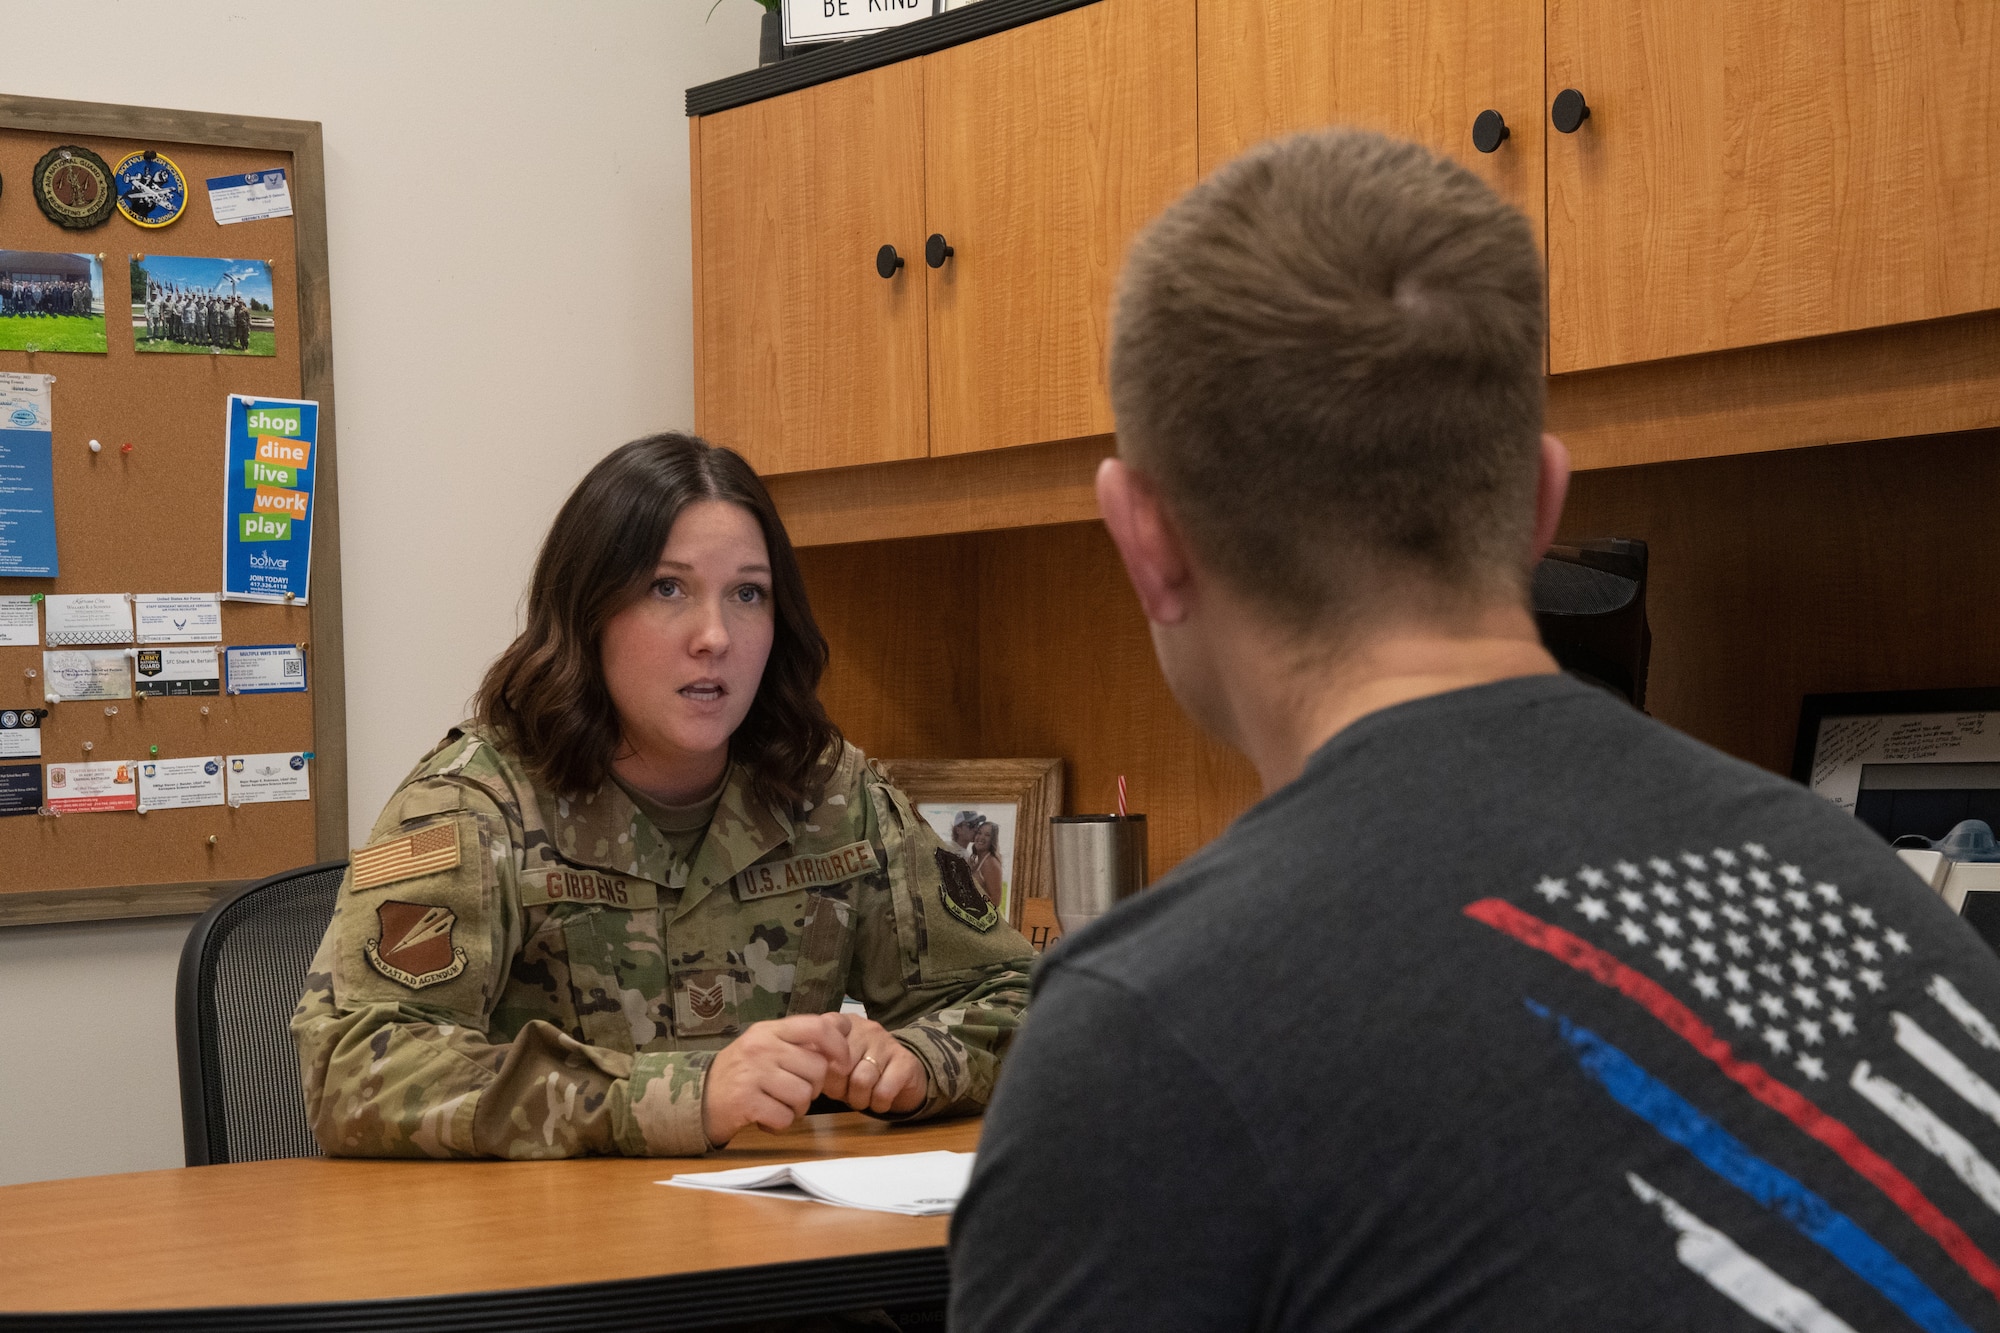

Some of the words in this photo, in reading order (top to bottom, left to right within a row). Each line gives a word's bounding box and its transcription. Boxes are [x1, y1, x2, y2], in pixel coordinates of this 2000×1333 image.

[824, 0, 850, 17] BE
[49, 158, 78, 175] NATIONAL
[80, 160, 100, 178] GUARD
[166, 166, 184, 192] SCHOOL
[49, 196, 81, 216] RECRUITING
[249, 412, 298, 434] shop
[260, 441, 304, 460] dine
[254, 464, 289, 483] live
[256, 491, 306, 511] work
[246, 517, 287, 538] play
[250, 552, 289, 568] bolivar
[265, 576, 288, 584] TODAY!
[546, 872, 629, 904] GIBBENS
[744, 867, 782, 895] U.S.
[374, 957, 402, 979] PARATI
[403, 975, 417, 985] AD
[418, 964, 459, 985] AGENDUM
